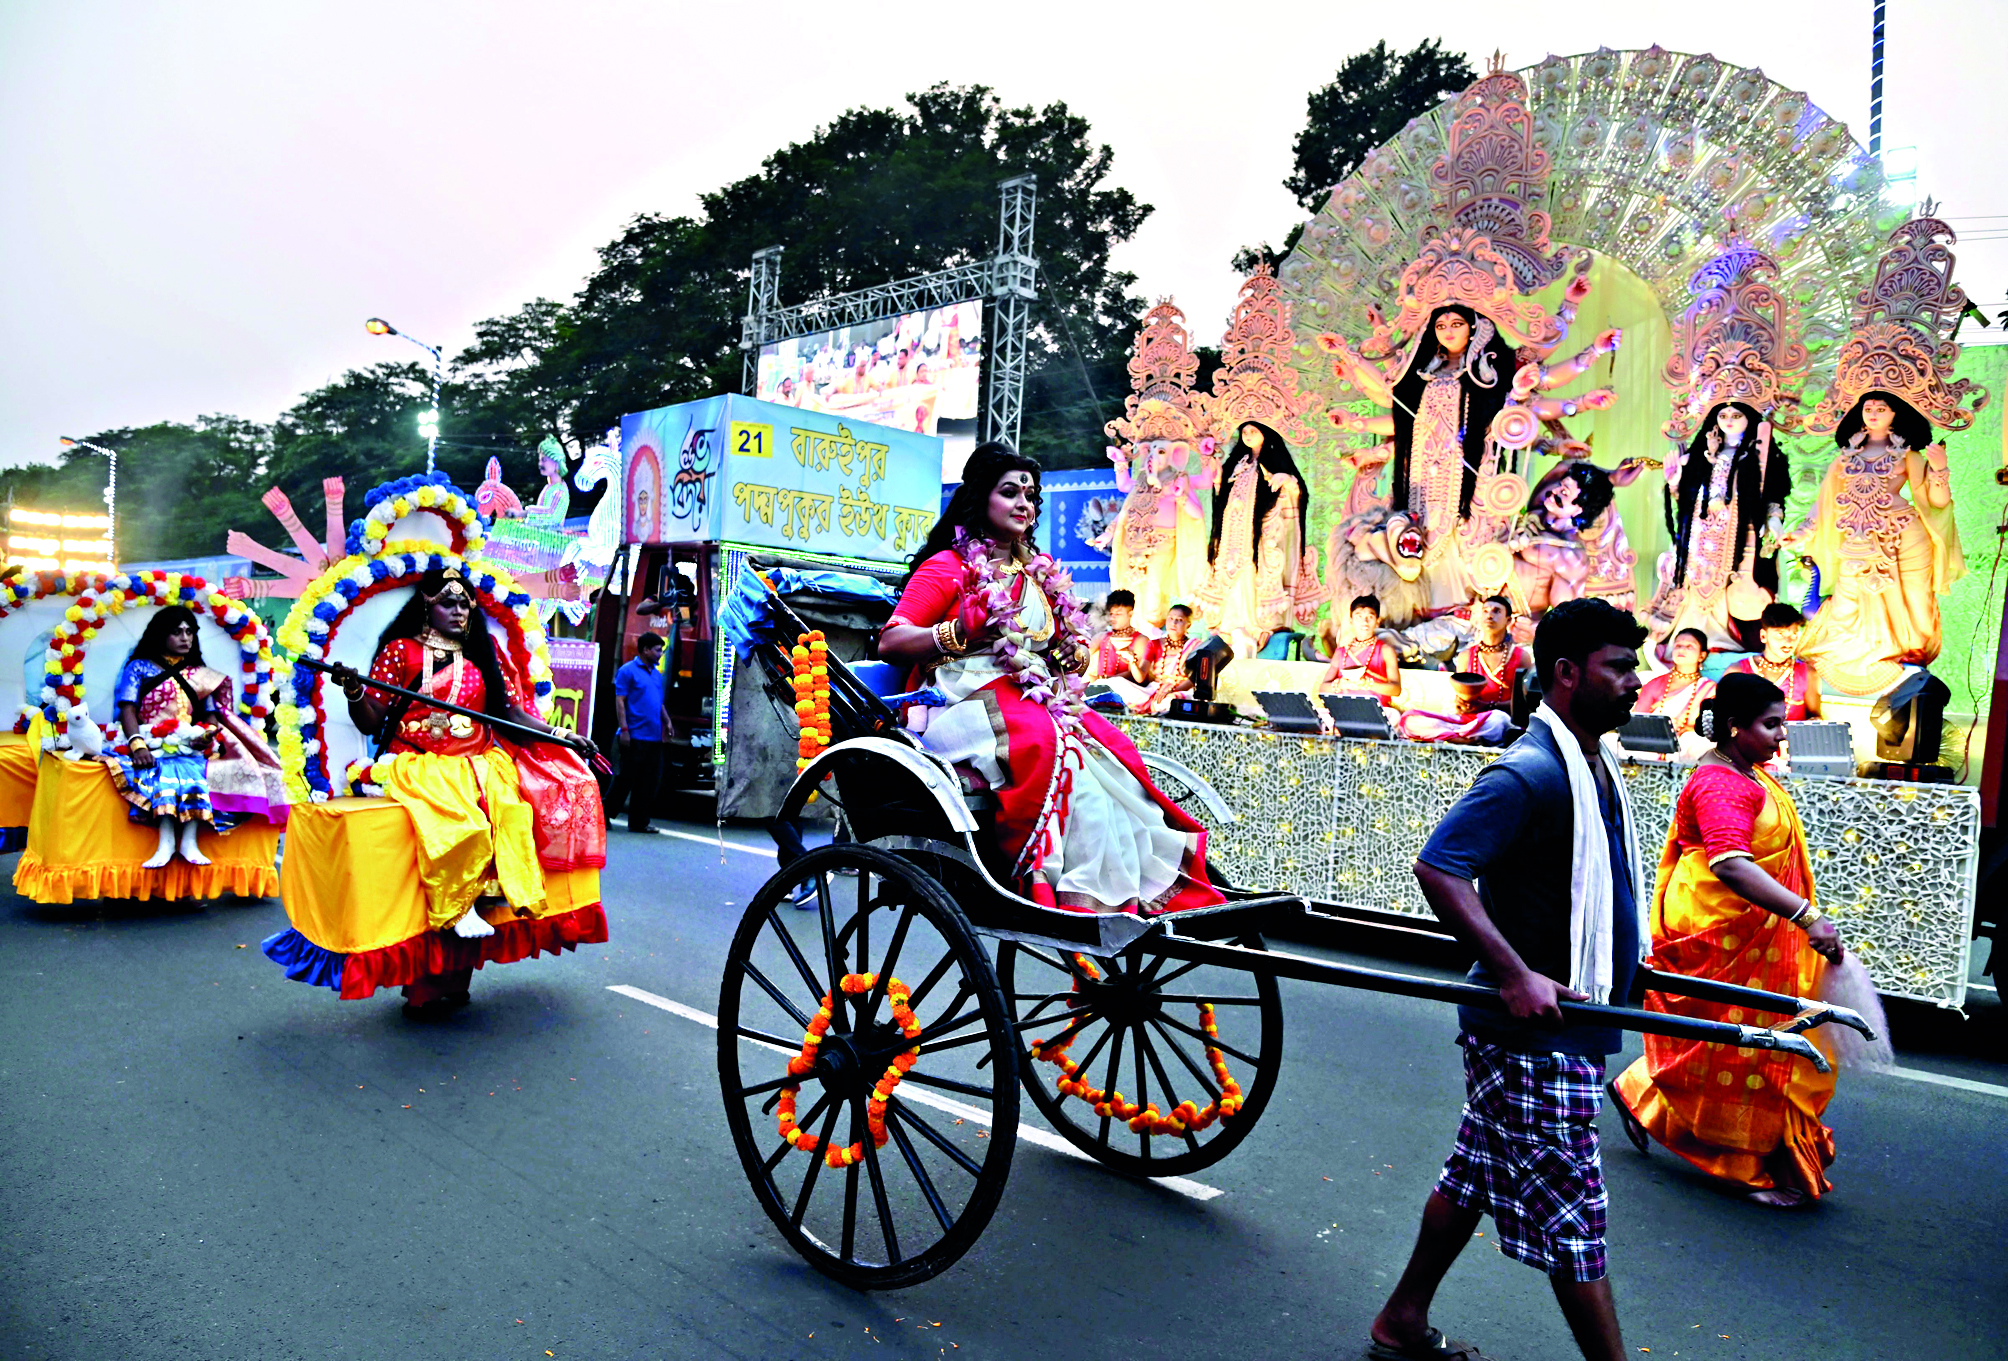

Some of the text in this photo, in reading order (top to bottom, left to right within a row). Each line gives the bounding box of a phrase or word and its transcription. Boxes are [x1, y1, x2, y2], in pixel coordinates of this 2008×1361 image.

[738, 429, 763, 453] 21
[790, 422, 889, 490] বারুইপুর
[839, 484, 890, 541] ইউথ
[894, 505, 935, 551] ক্লাব
